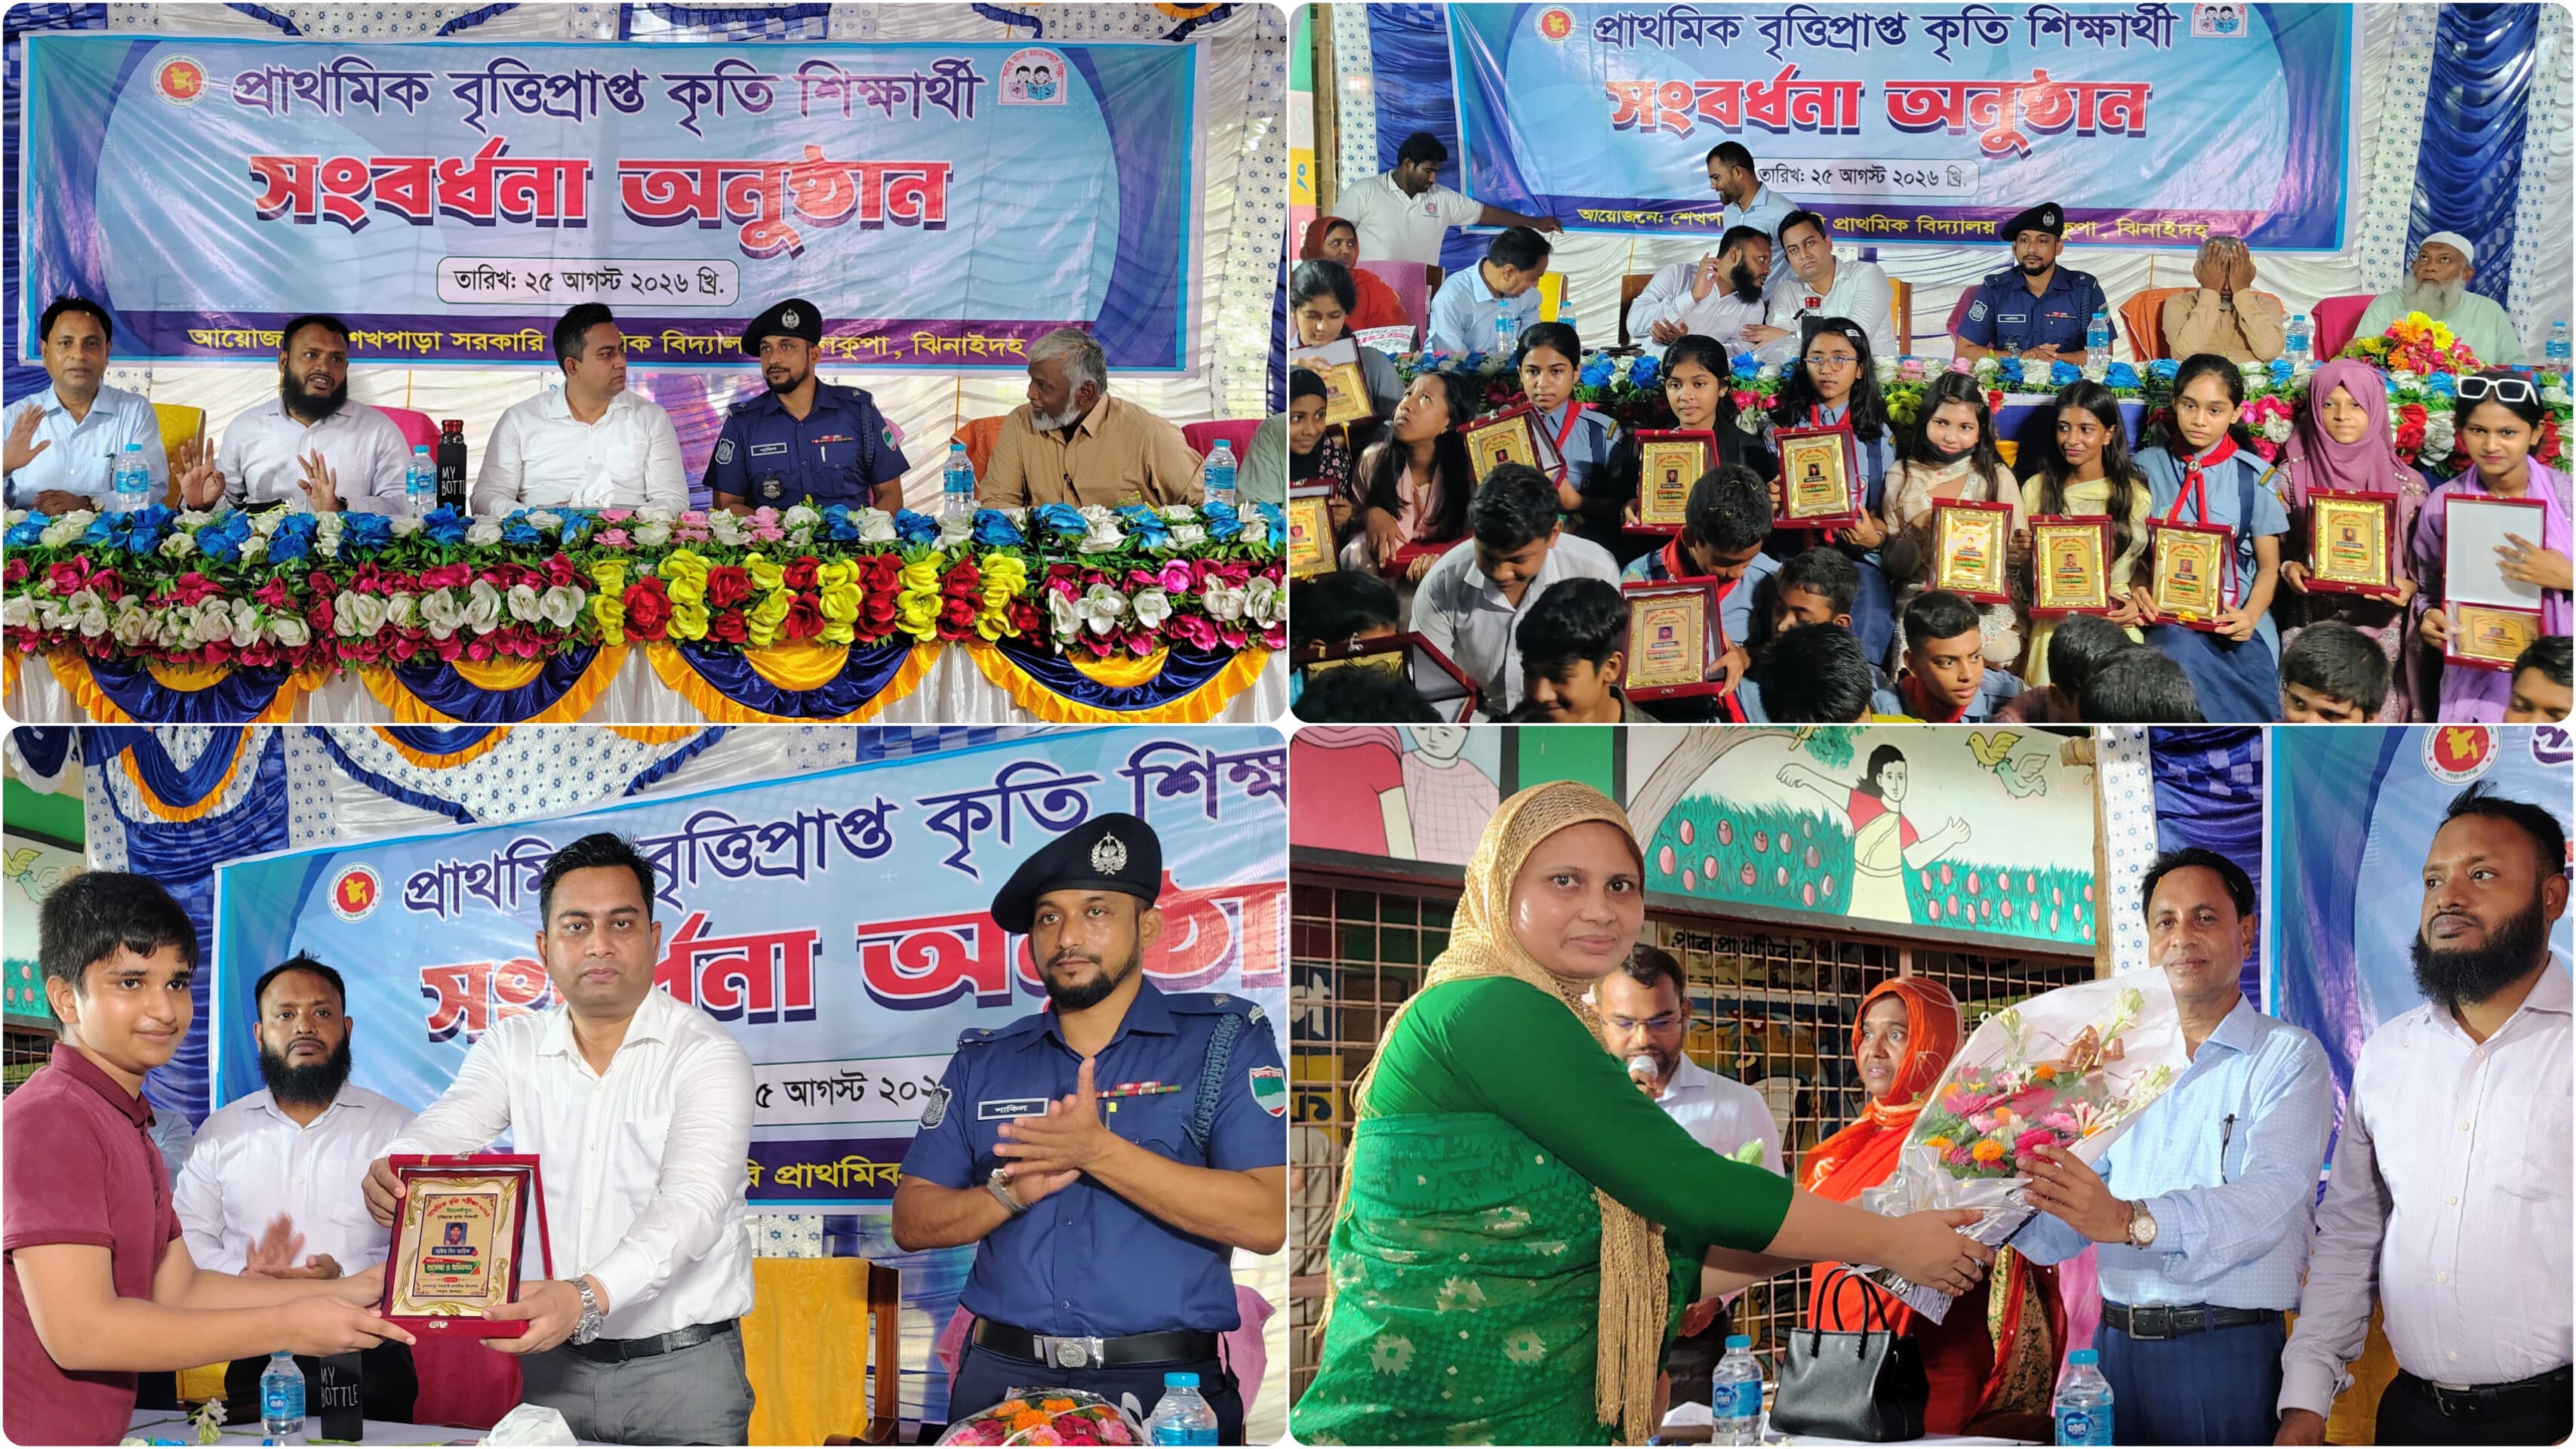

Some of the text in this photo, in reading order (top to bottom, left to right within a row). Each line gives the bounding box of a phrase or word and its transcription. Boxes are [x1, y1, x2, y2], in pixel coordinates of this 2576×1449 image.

[1593, 3, 2181, 64] প্রাথমিক বৃত্তিপ্রাপ্ত কৃতি শিক্ষার্থী
[232, 56, 986, 139] প্রাথমিক বৃত্তিপ্রাপ্ত কৃতি শিক্ষার্থী
[1605, 63, 2153, 161] সংবর্ধনা অনুষ্ঠান
[1811, 168, 1833, 187] ২৫
[1839, 164, 1888, 185] আগস্ট
[1893, 169, 1939, 188] ২০২৬
[248, 135, 953, 260] সংবর্ধনা অনুষ্ঠান
[1833, 214, 1910, 233] প্রাথমিক
[1915, 214, 1998, 235] বিদ্যালয়
[2116, 217, 2211, 239] ঝিনাইদহ
[525, 271, 554, 294] ২৫
[561, 265, 623, 292] আগস্ট
[631, 274, 688, 295] ২০২৬
[697, 266, 725, 296] খ্রি.
[186, 328, 285, 349] আয়োজ
[452, 328, 547, 352] সরকারি
[659, 329, 743, 355] বিদ্যাল
[909, 331, 1027, 358] ঝিনাইদহ
[442, 465, 455, 479] MY
[442, 480, 466, 496] BOTTL
[403, 835, 555, 921] প্রাথমি
[636, 795, 900, 912] বৃত্তিপ্রাপ্ত
[914, 761, 1105, 881] কৃতি
[756, 1069, 938, 1108] ৫ আগস্ট ২০২
[321, 1366, 335, 1386] MY
[321, 1384, 359, 1407] BOTTLE
